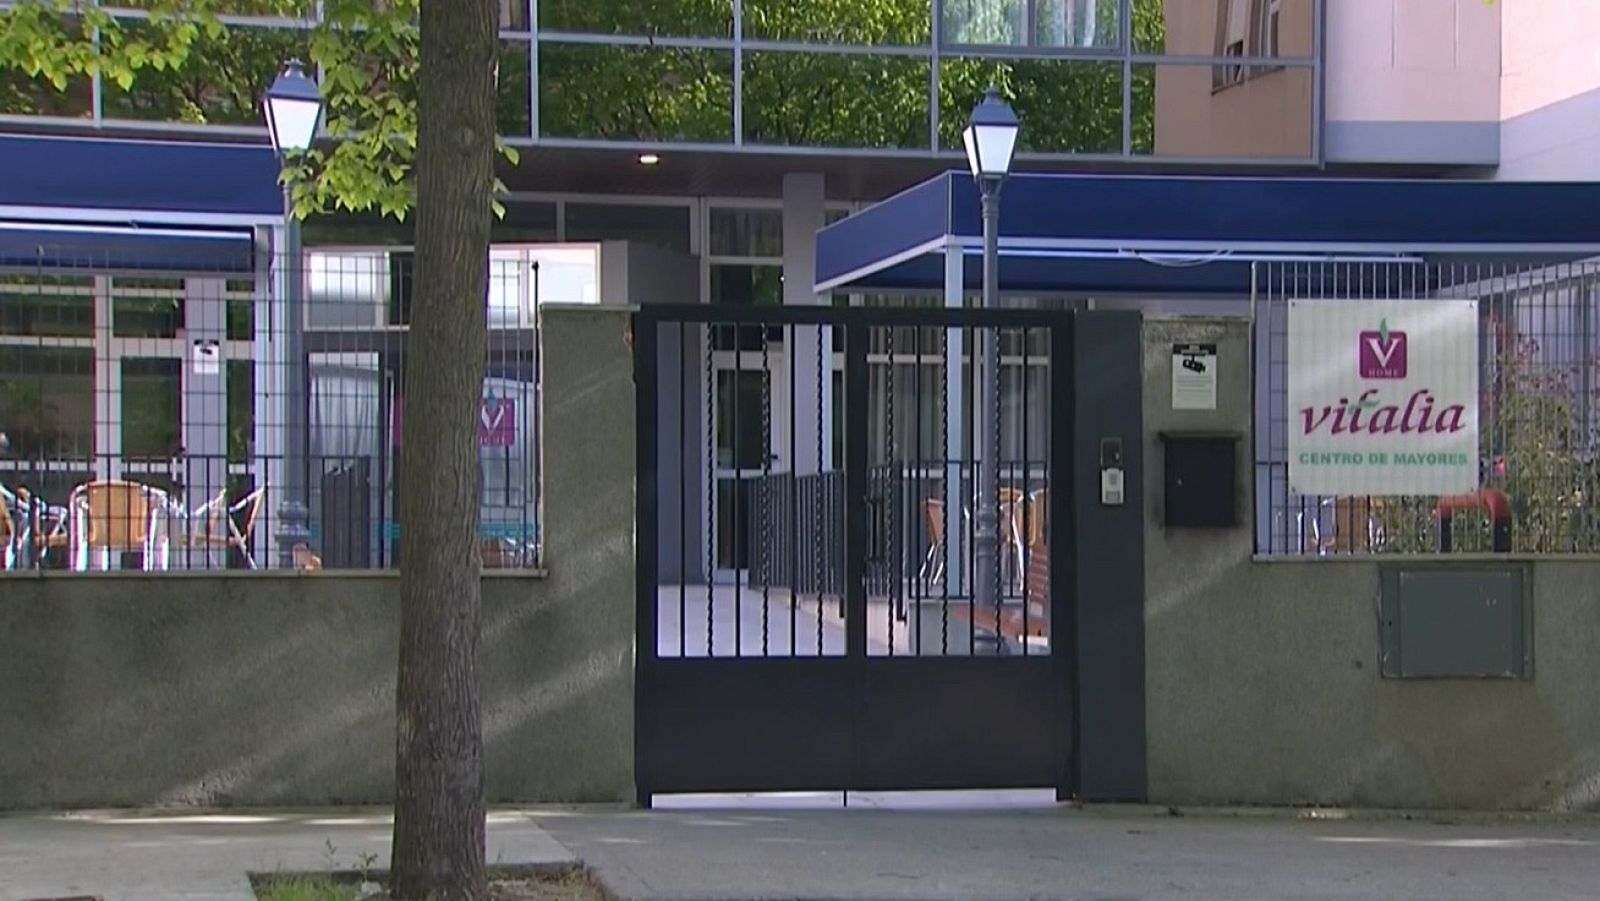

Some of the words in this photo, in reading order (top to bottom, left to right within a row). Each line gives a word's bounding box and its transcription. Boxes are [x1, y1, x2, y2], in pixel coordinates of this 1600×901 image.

[1366, 338, 1401, 368] V
[1368, 368, 1399, 377] HOME
[1300, 389, 1466, 435] vitalia
[1299, 452, 1363, 465] CENTRO
[1369, 452, 1388, 465] DE
[1394, 452, 1467, 465] MAYORES
